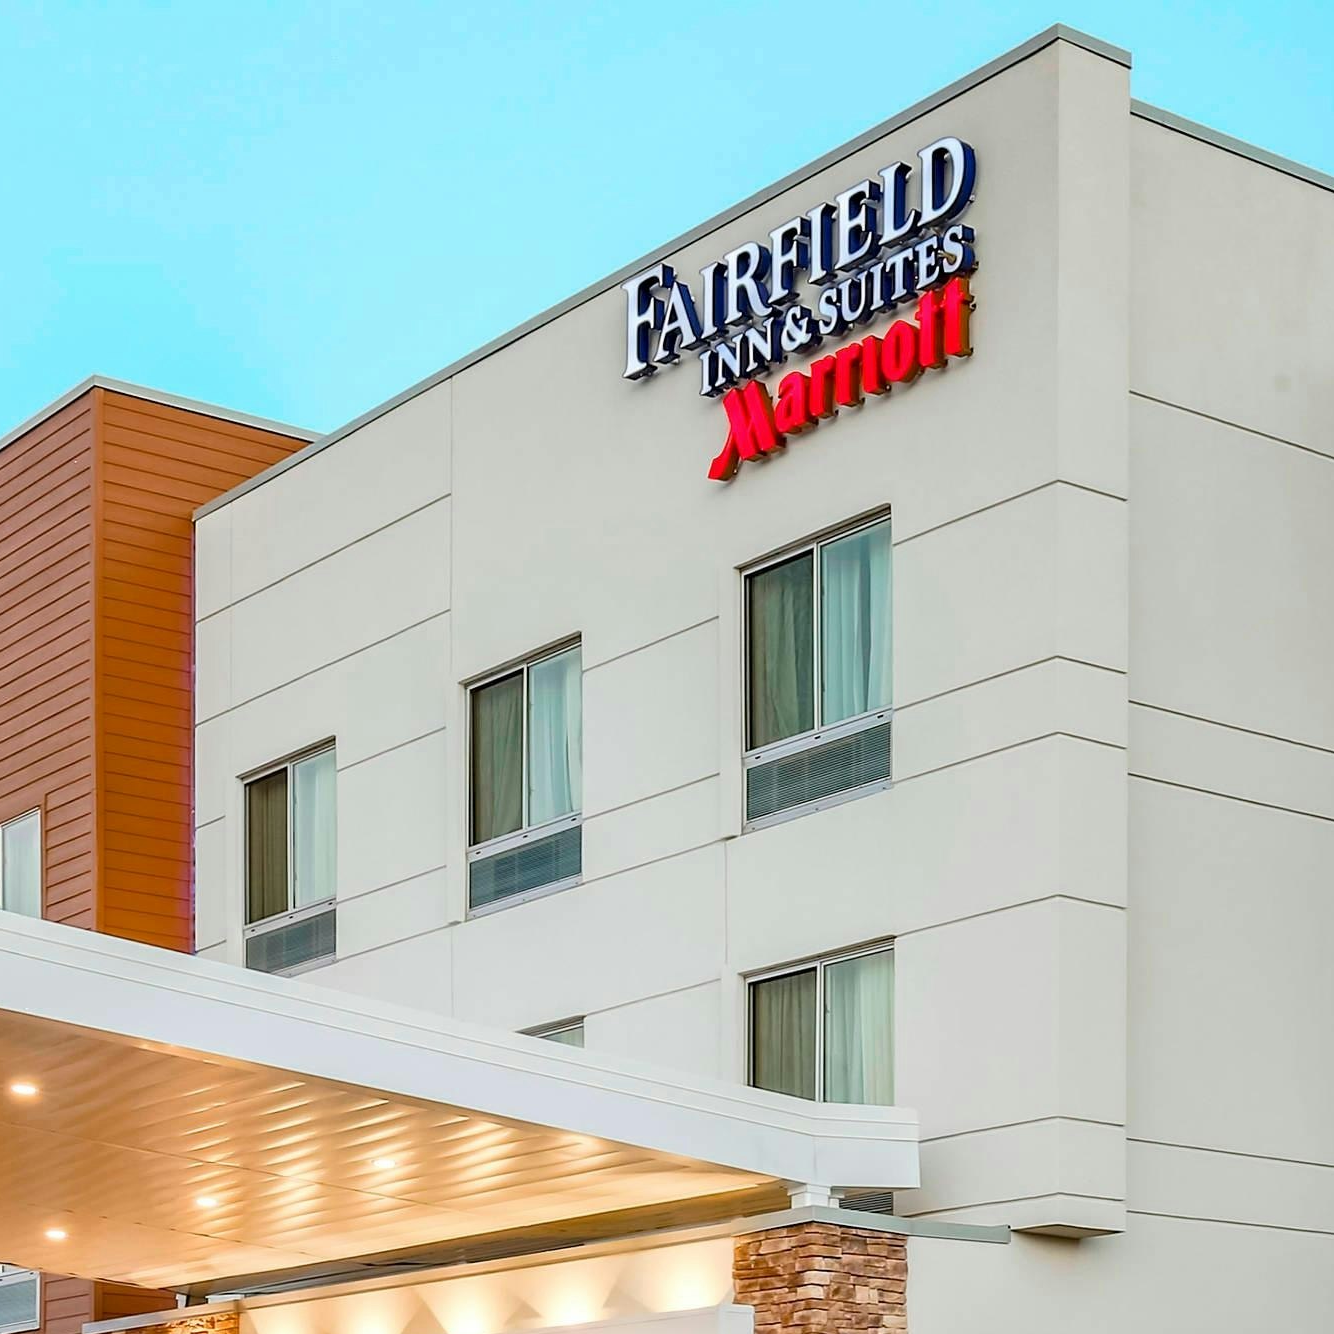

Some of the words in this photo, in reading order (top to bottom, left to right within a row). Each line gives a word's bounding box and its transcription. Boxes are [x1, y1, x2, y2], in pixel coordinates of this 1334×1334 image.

[621, 136, 977, 380] FAIRFIELD
[699, 315, 784, 397] INN
[779, 304, 819, 354] &
[817, 224, 977, 336] SUITES
[707, 274, 975, 481] Marriott
